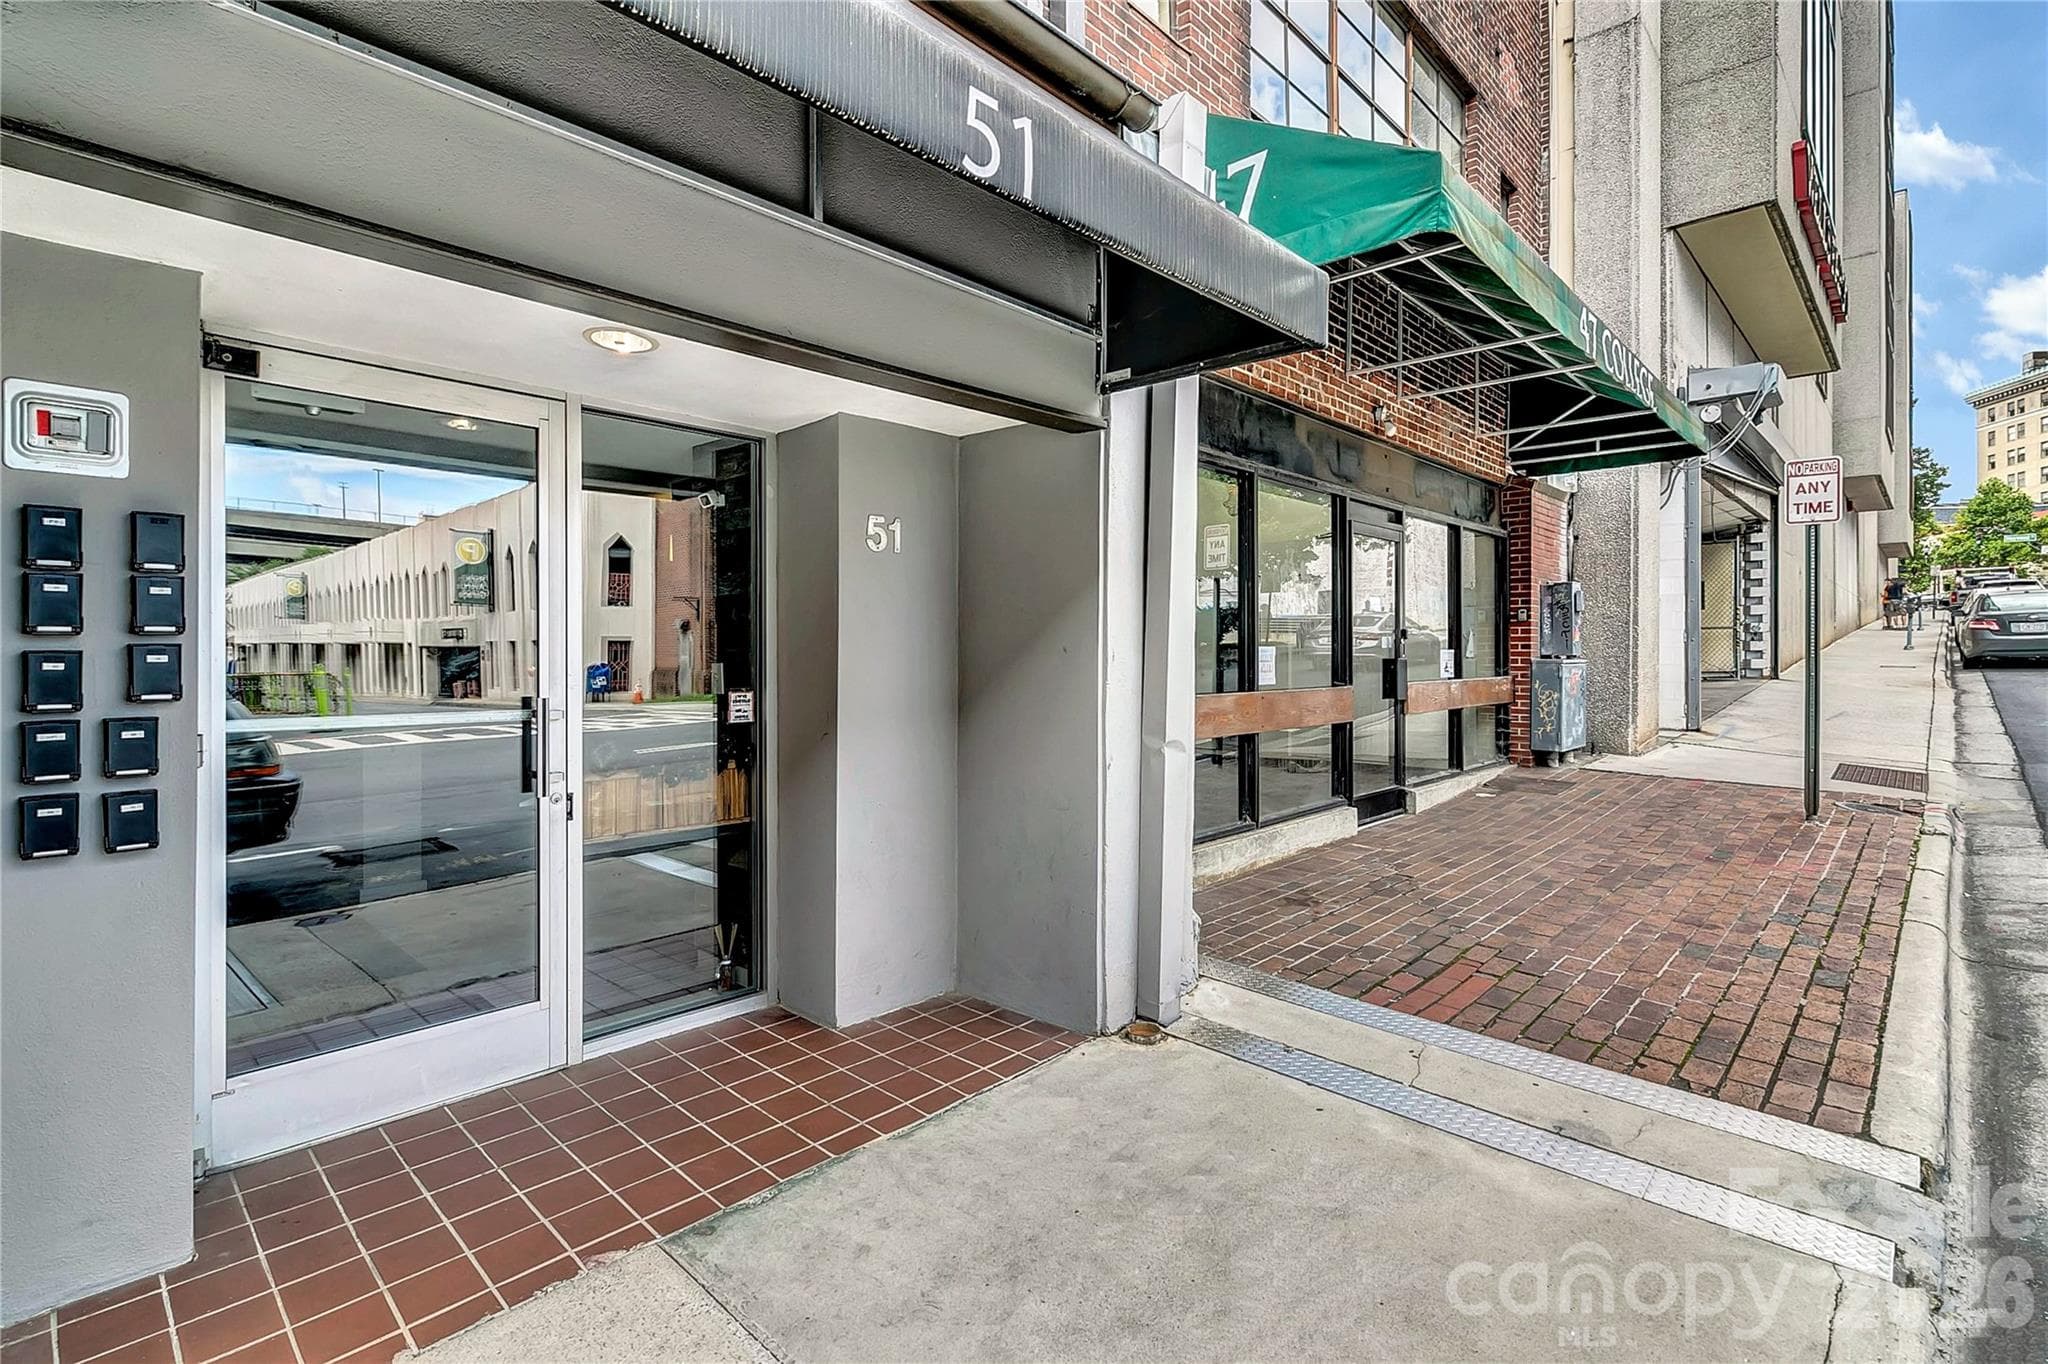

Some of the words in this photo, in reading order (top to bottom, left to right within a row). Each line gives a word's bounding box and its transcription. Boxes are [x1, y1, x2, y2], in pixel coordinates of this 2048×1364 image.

[961, 84, 1033, 200] 51
[1580, 306, 1597, 360] 47
[1602, 329, 1655, 408] COLLEGE
[1788, 464, 1803, 476] NO
[1804, 461, 1837, 473] PARKING
[1795, 480, 1831, 495] ANY
[1793, 500, 1833, 515] TIME
[866, 515, 901, 553] 51
